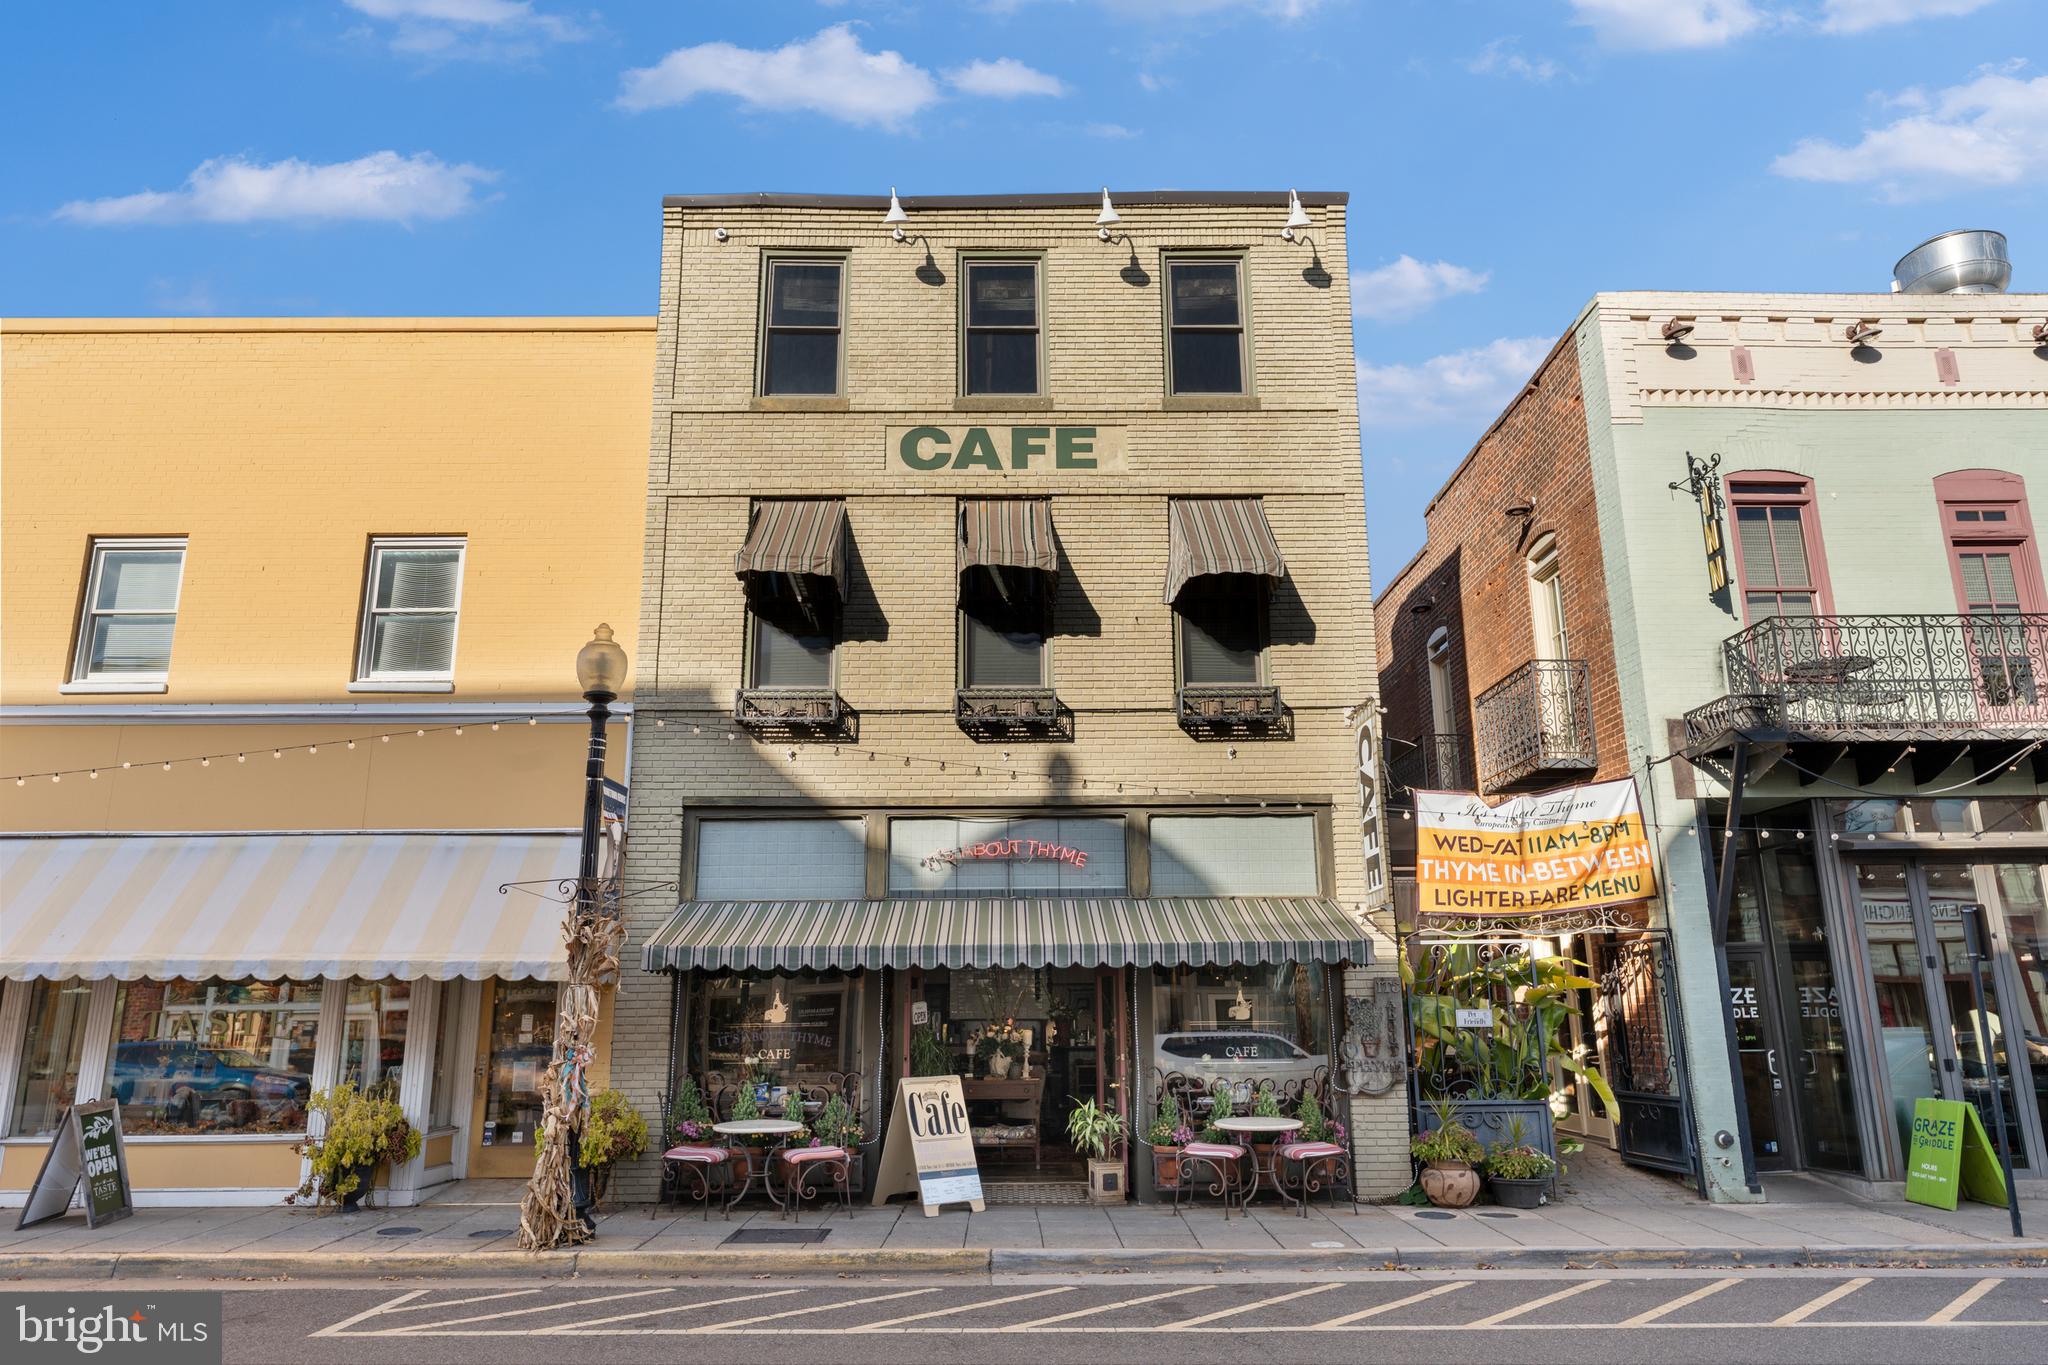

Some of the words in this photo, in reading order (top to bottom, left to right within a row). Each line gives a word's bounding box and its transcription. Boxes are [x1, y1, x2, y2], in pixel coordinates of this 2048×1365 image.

[900, 426, 1098, 471] CAFE
[1702, 486, 1726, 592] INN
[1358, 724, 1383, 891] CAFE
[1540, 793, 1598, 825] Thyme
[960, 839, 1024, 859] ABOUT
[1027, 839, 1089, 869] THYME
[1419, 858, 1502, 883] THYME
[1504, 845, 1650, 884] IN-BETWEEN
[1435, 888, 1526, 908] LIGHTER
[1527, 884, 1581, 908] FARE
[1584, 874, 1642, 899] MENU
[142, 1009, 294, 1042] TASTE
[913, 1011, 927, 1023] OPEN
[717, 1032, 740, 1047] IT'S
[741, 1030, 788, 1042] ABOUT
[790, 1031, 833, 1048] THYME
[1225, 1046, 1259, 1058] CAFE
[758, 1048, 791, 1060] CAFE
[908, 1090, 967, 1138] Cafe
[1913, 1117, 1956, 1137] GRAZE
[84, 1144, 112, 1161] WE'RE
[1918, 1135, 1955, 1151] GRIDDLE
[87, 1155, 118, 1178] OPEN
[93, 1182, 117, 1198] TASTE
